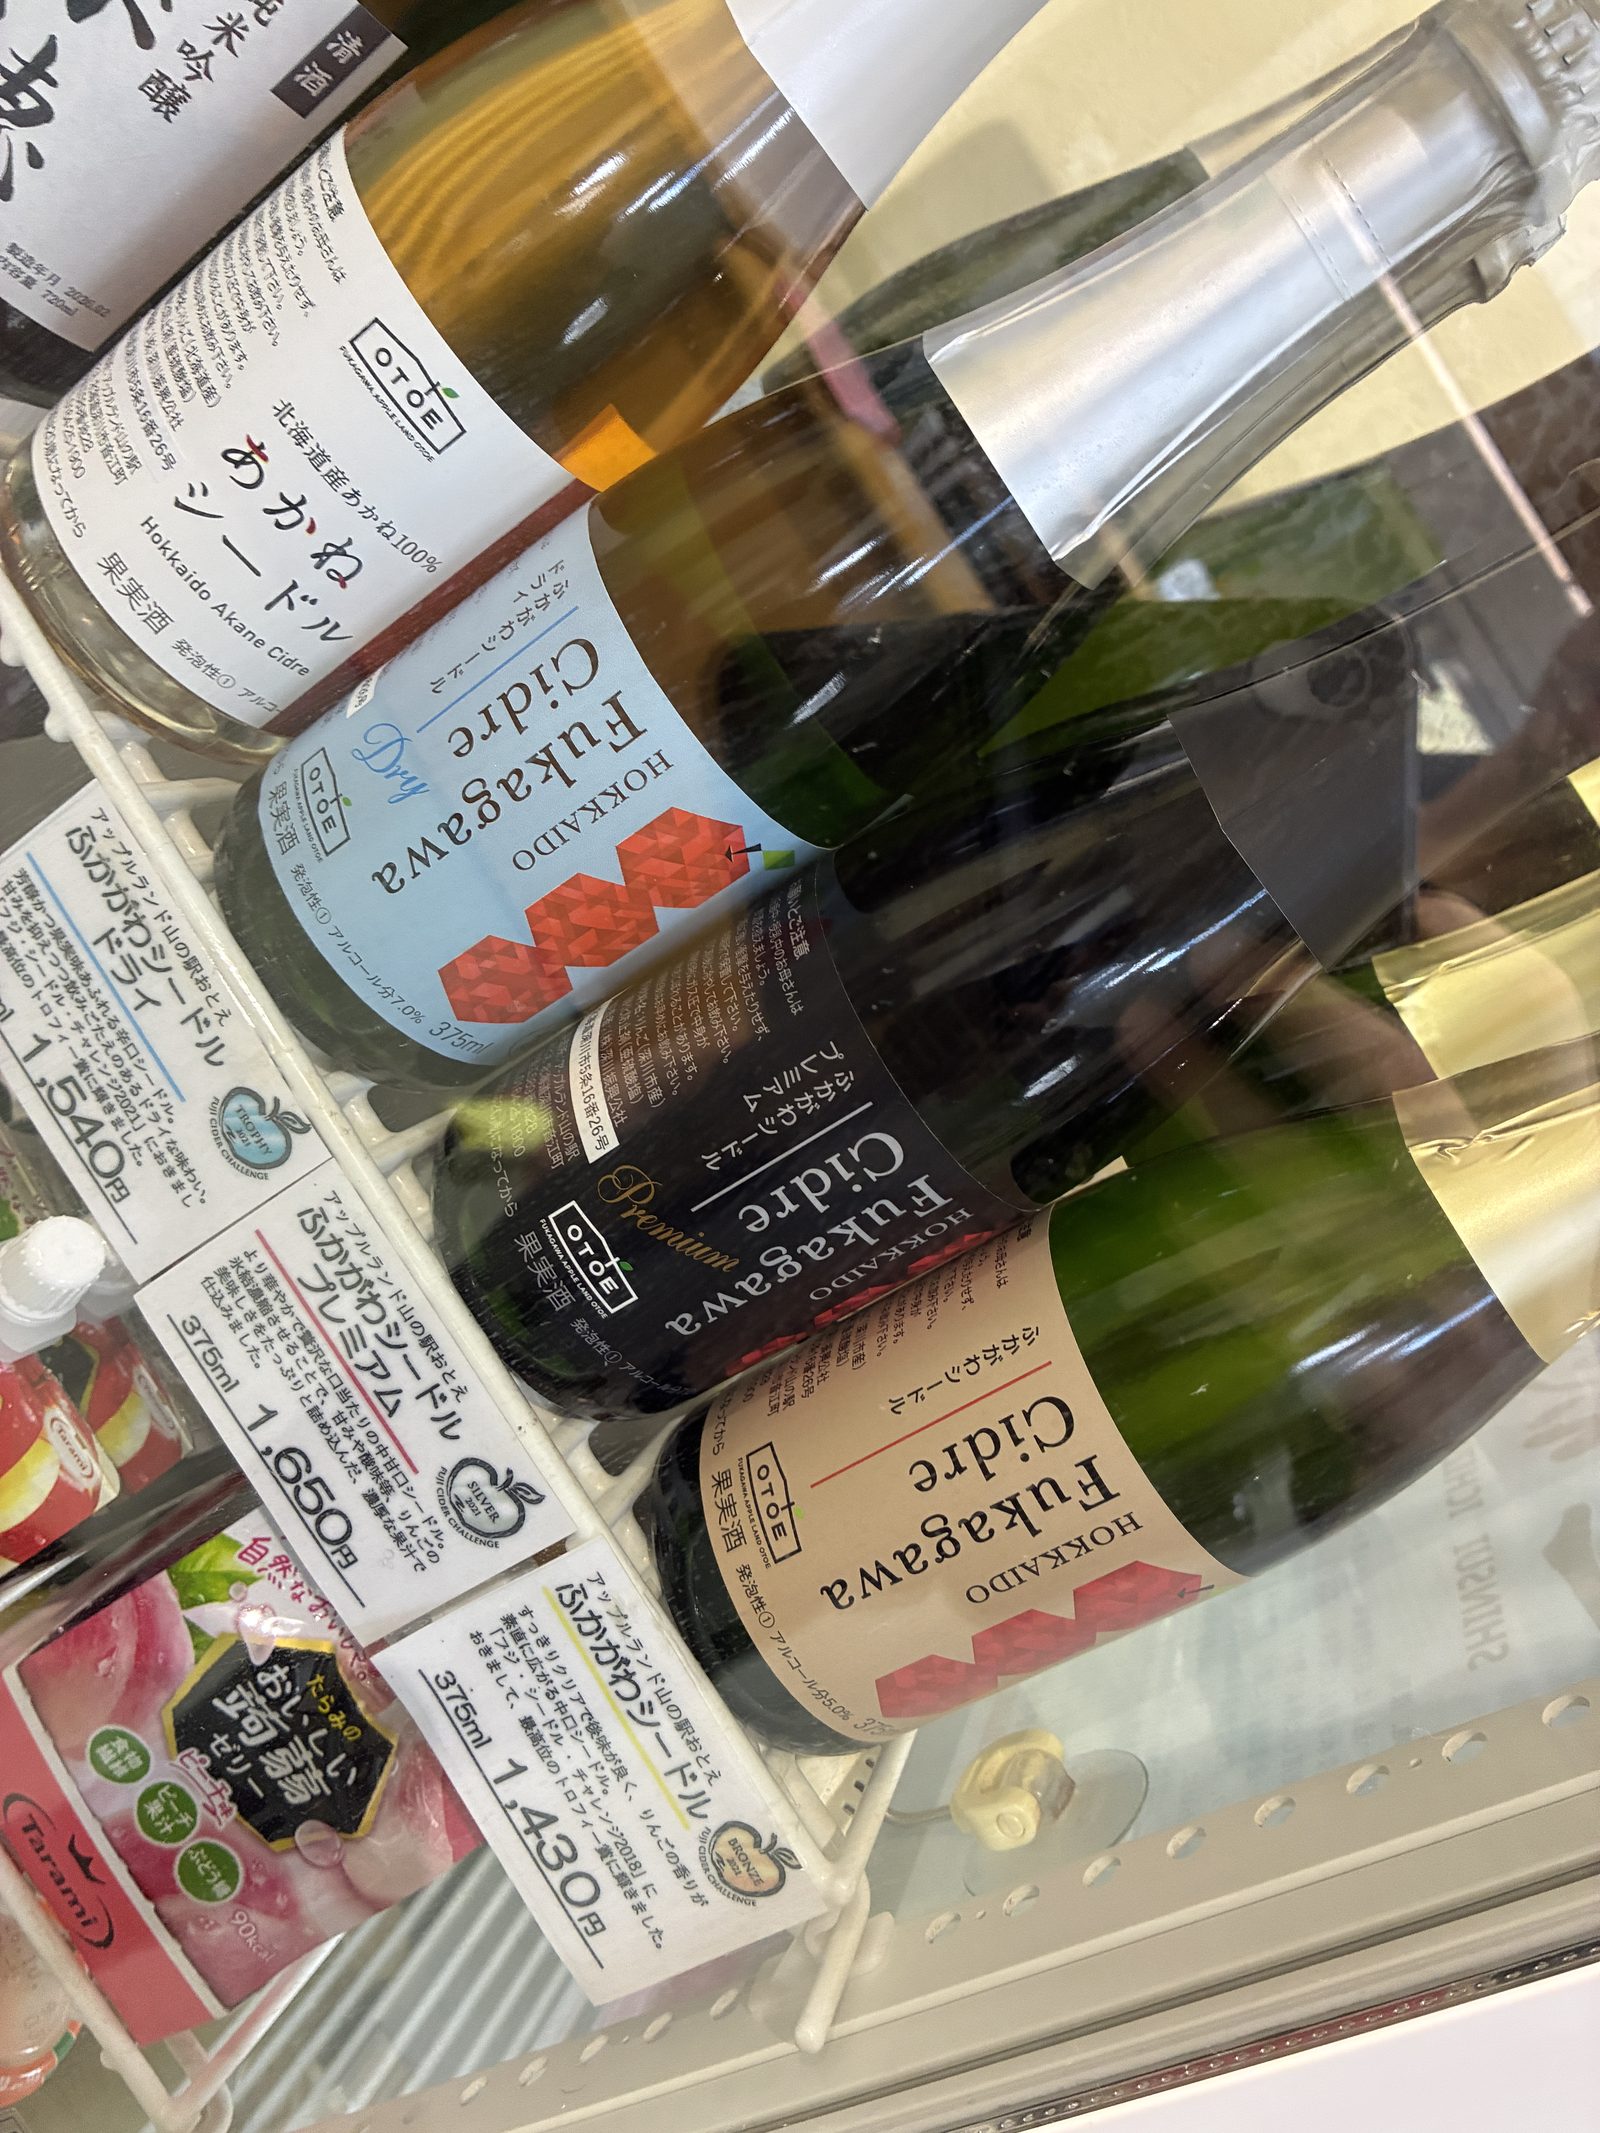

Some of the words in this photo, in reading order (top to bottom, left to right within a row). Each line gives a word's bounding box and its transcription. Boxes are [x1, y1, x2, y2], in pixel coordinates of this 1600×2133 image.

[292, 25, 368, 98] 清酒
[368, 344, 447, 434] OTOE
[216, 429, 368, 591] あかね
[266, 394, 445, 577] 北海道産あかね100%
[137, 513, 220, 604] Hokkaido
[208, 593, 271, 654] Akane
[263, 640, 313, 680] Cidre
[172, 476, 354, 651] シードル
[509, 558, 569, 605] ドライ
[93, 547, 176, 639] 果実酒
[171, 635, 238, 694] 発泡性①
[425, 577, 574, 696] ふかがわシードル
[443, 637, 606, 760] Cidre
[304, 766, 341, 834] OTOE
[351, 717, 432, 802] Dry
[368, 688, 648, 900] Fukagawa
[508, 746, 673, 875] HOKKAIDO
[61, 819, 233, 1073] ふかがわシードル
[87, 805, 234, 1027] アップルランド山の駅おとえ
[262, 780, 301, 856] 果実酒
[287, 861, 335, 927] 発泡性①
[326, 925, 426, 1025] アルコール分7.0%
[427, 1019, 493, 1055] 375ml
[10, 866, 181, 1125] 芳醇かつ果実味あふれる辛口シードル。
[88, 924, 165, 1021] ドライ
[0, 878, 213, 1205] 甘みを抑えつつ飲みごたえのあるドライな味わい。
[742, 1040, 842, 1113] プレミアム
[207, 1116, 226, 1149] CIDER
[208, 1095, 221, 1115] FUJI
[232, 1103, 273, 1158] TROPHY
[234, 1126, 252, 1147] 2021
[700, 1066, 858, 1175] ふかがわシードル
[220, 1147, 269, 1183] CHALLENGE
[733, 1127, 903, 1239] Cidre
[562, 1220, 621, 1297] OTOE
[594, 1165, 738, 1274] Premium
[663, 1171, 952, 1349] Fukagawa
[806, 1205, 973, 1305] HOKKAIDO
[320, 1188, 472, 1404] アップルランド山の駅おとえ
[509, 1228, 576, 1313] 果実酒
[535, 1218, 567, 1260] FUKAGAWA
[560, 1257, 581, 1284] APPLE
[575, 1280, 594, 1302] LAND
[589, 1297, 609, 1321] OTOE
[177, 1312, 240, 1395] 375ml
[196, 1274, 267, 1371] 仕込みました。
[293, 1200, 470, 1446] ふかがわシードル
[294, 1261, 413, 1420] プレミアム
[886, 1321, 1043, 1417] ふかがわシードル
[210, 1264, 428, 1577] 美味しさをたっぷりと詰め込んだ、濃厚な果汁で
[224, 1254, 442, 1567] 氷結濃縮させることで、甘みや酸味等、りんごの
[239, 1245, 453, 1551] より華やかで贅沢な口当たりの中甘口シードル。
[902, 1390, 1074, 1498] Cidre
[53, 1423, 90, 1472] Tarami
[433, 1465, 447, 1485] FUJI
[735, 1457, 748, 1501] FUKAGAWA
[433, 1484, 453, 1519] CIDER
[446, 1516, 501, 1551] CHALLENGE
[462, 1495, 483, 1518] 2021
[464, 1478, 502, 1525] SILVER
[741, 1498, 756, 1525] APPLE
[749, 1523, 763, 1547] LAND
[752, 1461, 790, 1541] OTOE
[817, 1451, 1120, 1616] Fukagawa
[704, 1467, 748, 1554] 果実酒
[732, 1560, 777, 1631] 発泡性①
[768, 1630, 854, 1722] アルコール分5.0%
[756, 1545, 772, 1570] OTOE
[962, 1508, 1143, 1610] HOKKAIDO
[257, 1660, 364, 1791] おいしい
[304, 1673, 363, 1743] たらみの
[430, 1667, 493, 1751] 375ml
[498, 1611, 615, 1797] 素直に広がる中口シードル。
[551, 1575, 720, 1826] ふかがわシードル
[585, 1570, 724, 1788] アップルランド山の駅おとえ
[176, 1747, 241, 1821] ピーチ味
[204, 1728, 265, 1803] ゼリー
[210, 1675, 334, 1814] 蒟蒻
[465, 1627, 669, 1951] おきまして、最高位のトロフィー賞に輝きました。
[514, 1603, 711, 1911] すっきりクリアで後味が良く、りんごの香りが
[141, 1796, 178, 1838] 果汁
[154, 1784, 194, 1831] ピーチ
[697, 1827, 712, 1845] FUJI
[14, 1812, 99, 1931] Tarami
[694, 1842, 713, 1876] CIDER
[707, 1873, 756, 1908] CHALLENGE
[724, 1835, 765, 1889] BRONZE
[724, 1854, 743, 1877] 2021
[226, 1906, 277, 1963] 90kcal
